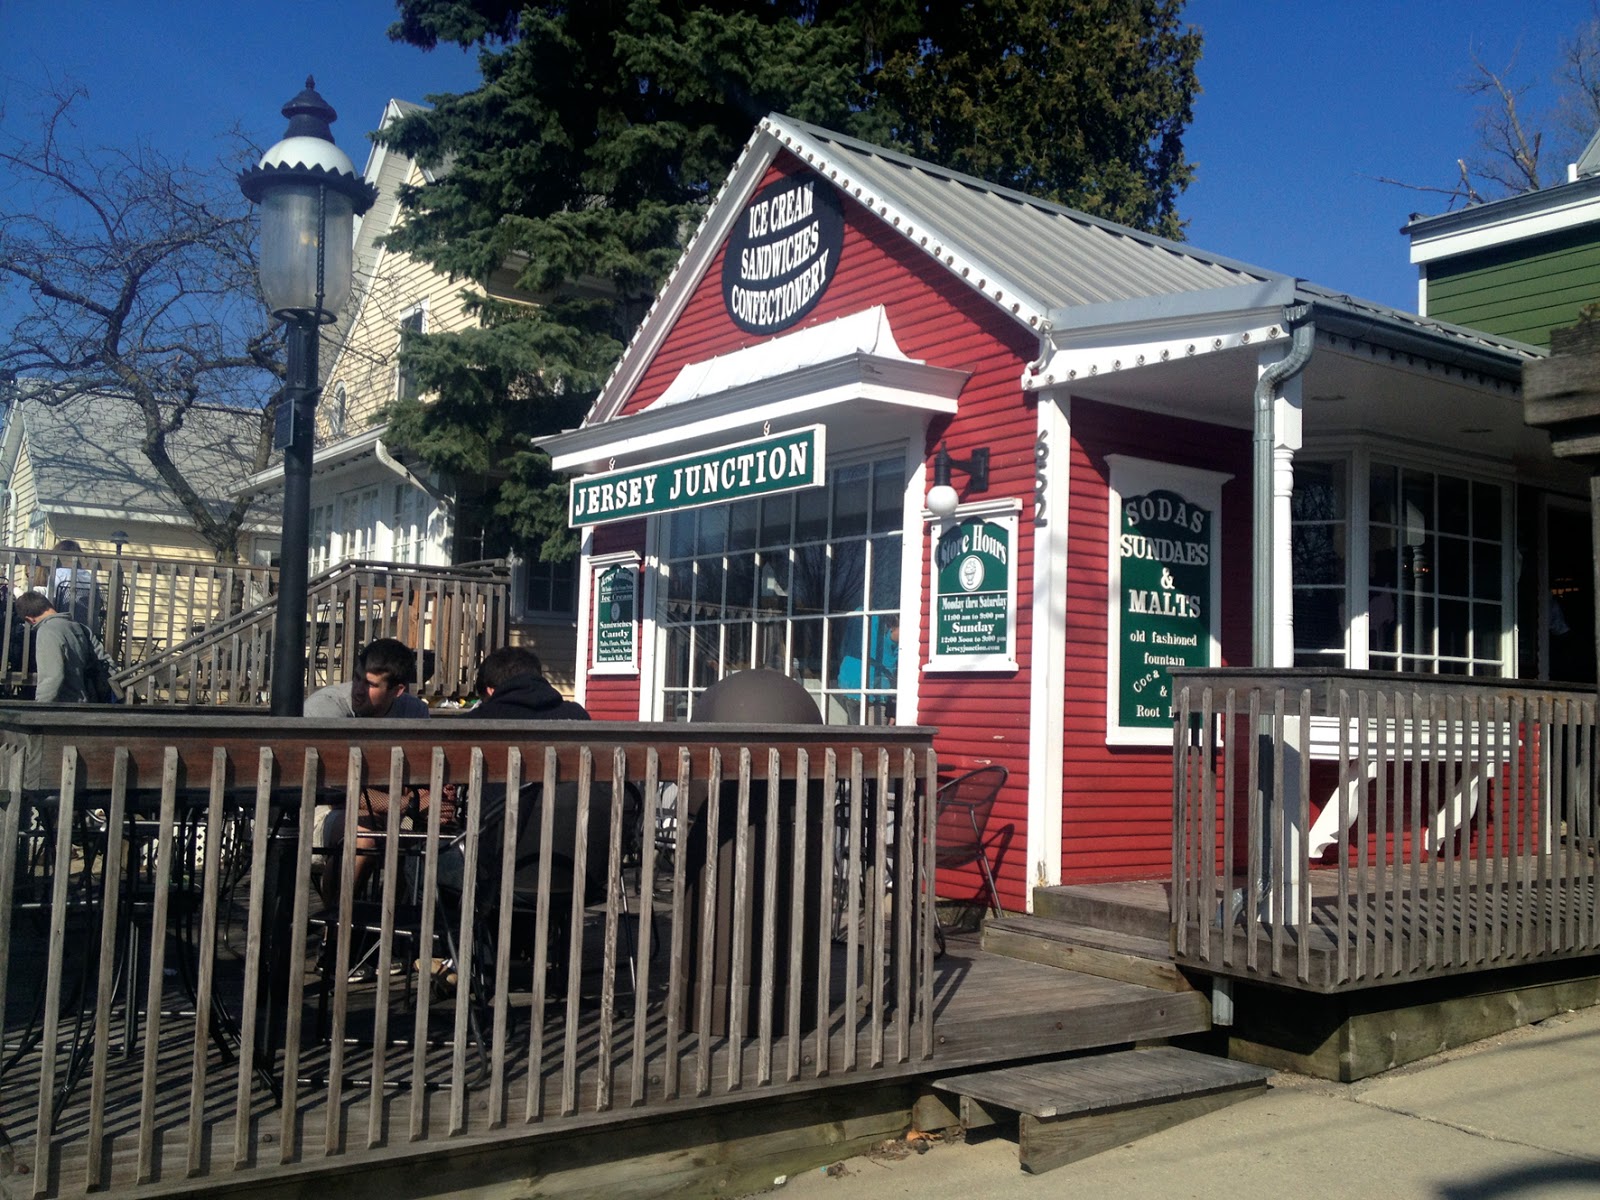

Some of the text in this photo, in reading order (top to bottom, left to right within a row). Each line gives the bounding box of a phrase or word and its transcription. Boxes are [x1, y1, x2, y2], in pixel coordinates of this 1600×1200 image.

[748, 180, 815, 239] ICE CREAM
[741, 220, 819, 280] SANDWICHES
[731, 248, 830, 325] CONFECTIONERY
[575, 441, 808, 516] JERSEY JUNCTION
[1125, 498, 1204, 533] SODAS
[941, 525, 1007, 573] Store Hours
[1120, 533, 1209, 566] SUNDAES
[1160, 567, 1175, 589] &
[942, 594, 1006, 612] Monday thru Saturday
[1128, 589, 1201, 618] MALTS
[600, 621, 632, 629] Sandwiches
[980, 612, 994, 620] 9:00
[995, 613, 1005, 621] pm
[602, 629, 629, 640] Candy
[952, 621, 995, 635] Sunday
[1130, 630, 1197, 646] old fashioned
[946, 645, 1000, 653] jerseyjunction.com
[1144, 652, 1185, 666] fountain
[1133, 669, 1160, 693] Coca
[1160, 685, 1167, 697] &
[1136, 704, 1160, 718] Root
